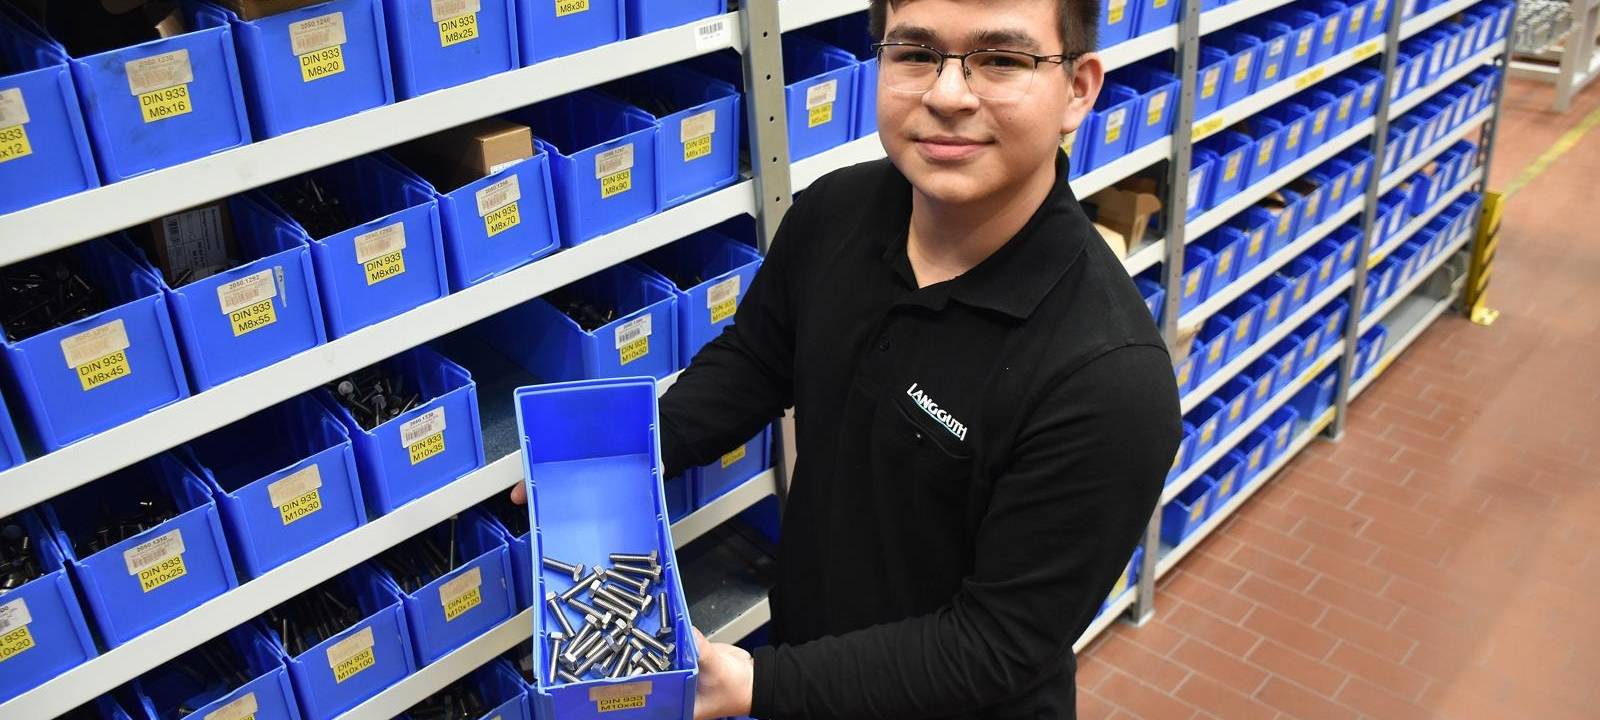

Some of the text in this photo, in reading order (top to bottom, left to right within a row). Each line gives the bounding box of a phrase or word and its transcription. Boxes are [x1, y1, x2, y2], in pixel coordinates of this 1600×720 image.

[560, 1, 585, 13] M8x30
[441, 15, 475, 32] DIN 933
[446, 29, 474, 43] M8x25
[302, 48, 340, 66] DIN 933
[308, 62, 339, 78] M8x20
[142, 87, 186, 106] DIN 933
[150, 101, 185, 118] M8x16
[0, 128, 23, 143] 933
[602, 170, 630, 187] DIN 933
[605, 182, 627, 195] M8x90
[486, 204, 517, 225] DIN 933
[491, 216, 516, 233] M8x70
[366, 252, 401, 272] DIN 933
[371, 264, 400, 281] M8x60
[232, 301, 271, 323] DIN 933
[238, 314, 271, 332] M8x55
[621, 338, 647, 355] DIN 933
[80, 352, 124, 376] DIN 933
[87, 367, 124, 386] M8x45
[906, 382, 968, 441] LANGGUTH
[411, 434, 442, 453] DIN 933
[412, 443, 443, 461] M10x35
[282, 492, 317, 512] DIN 933
[285, 501, 319, 521] M10x30
[141, 557, 181, 579] DIN 933
[145, 567, 184, 589] M10x25
[447, 589, 476, 610] DIN 933
[447, 596, 480, 619] M10x120
[5, 629, 26, 643] 933
[337, 650, 370, 671] DIN 933
[338, 658, 373, 681] M10x100
[601, 701, 643, 711] M10x40
